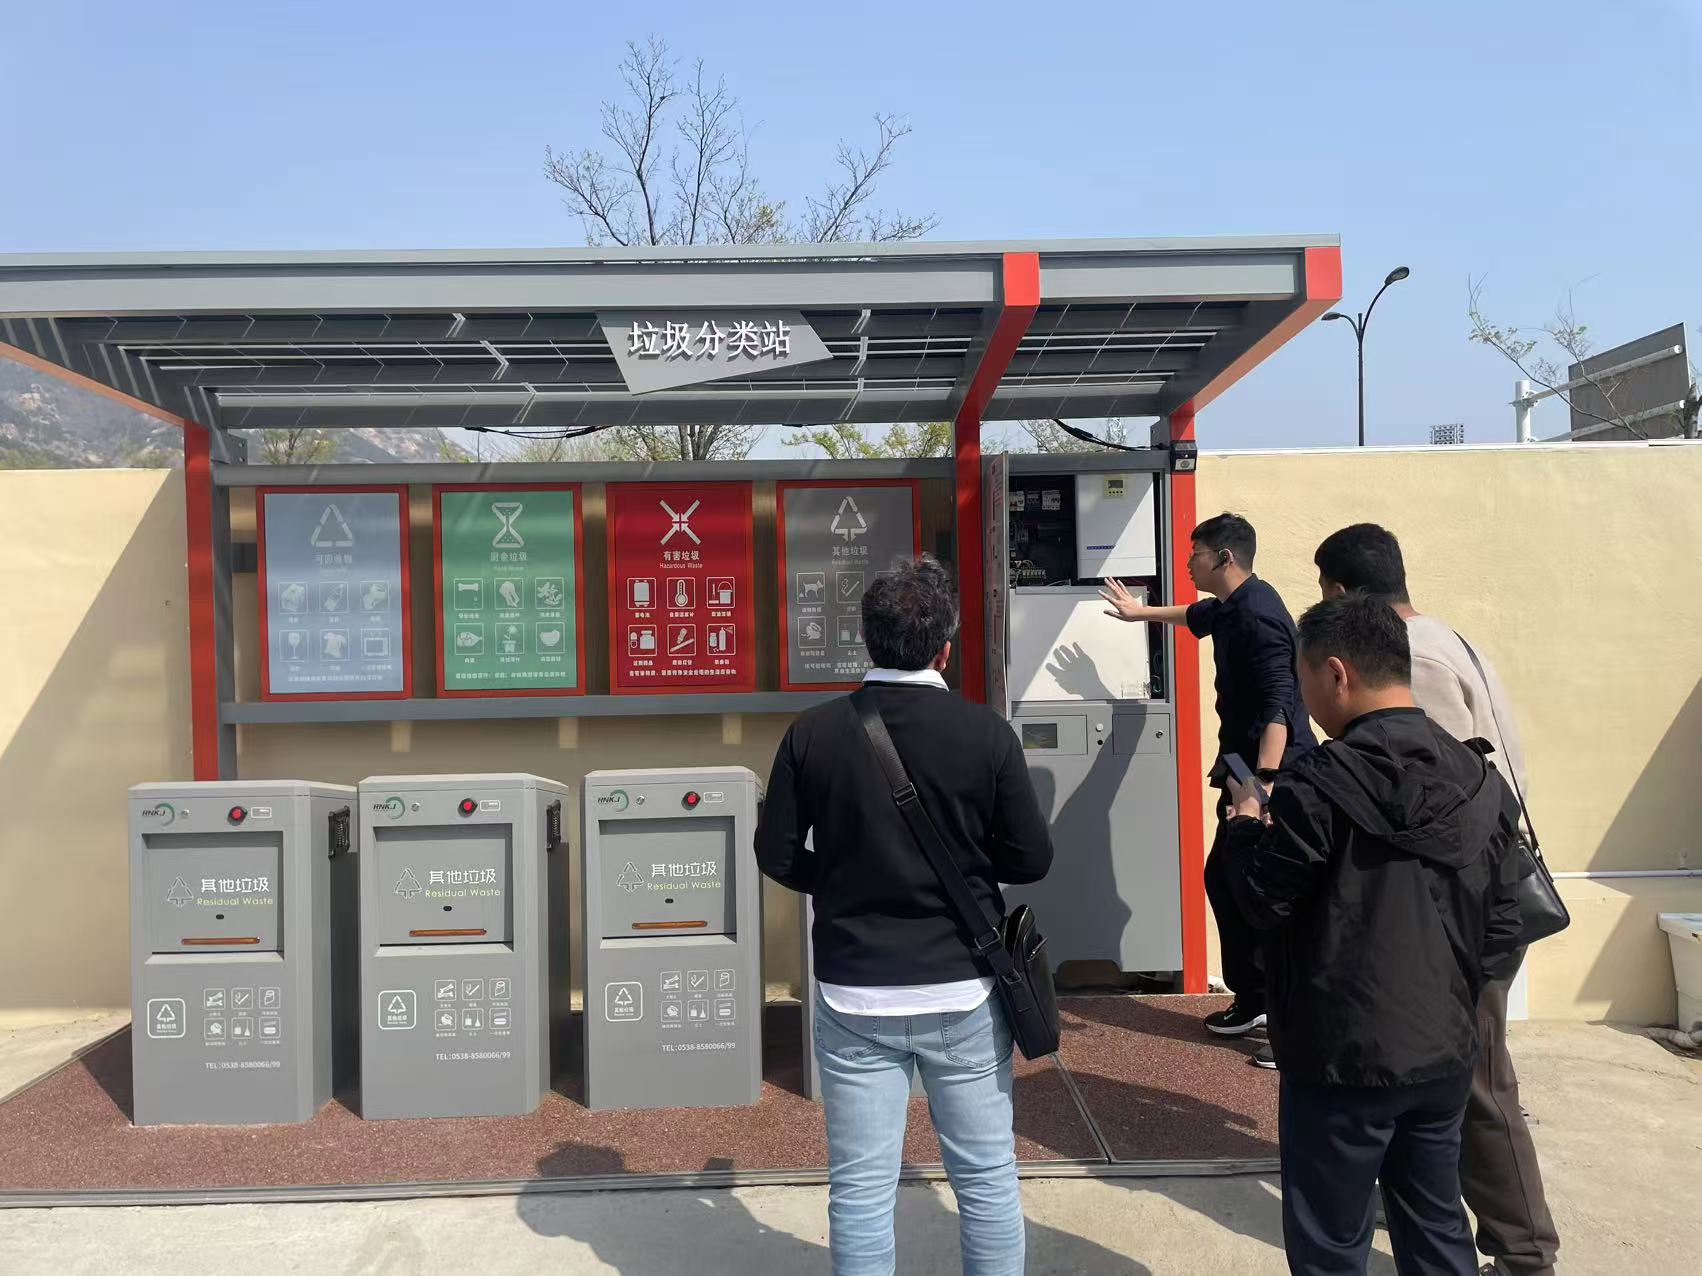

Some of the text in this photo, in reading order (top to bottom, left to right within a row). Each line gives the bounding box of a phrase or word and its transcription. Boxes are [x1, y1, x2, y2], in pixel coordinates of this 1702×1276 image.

[630, 320, 791, 356] 垃圾分类站
[663, 551, 700, 561] 有害垃圾
[429, 868, 496, 884] 其他垃圾
[651, 861, 717, 878] 其他垃圾
[201, 877, 269, 893] 其他垃圾
[647, 881, 721, 891] Residual Waste
[425, 889, 501, 898] Residual Waste
[197, 897, 273, 906] Residual Waste
